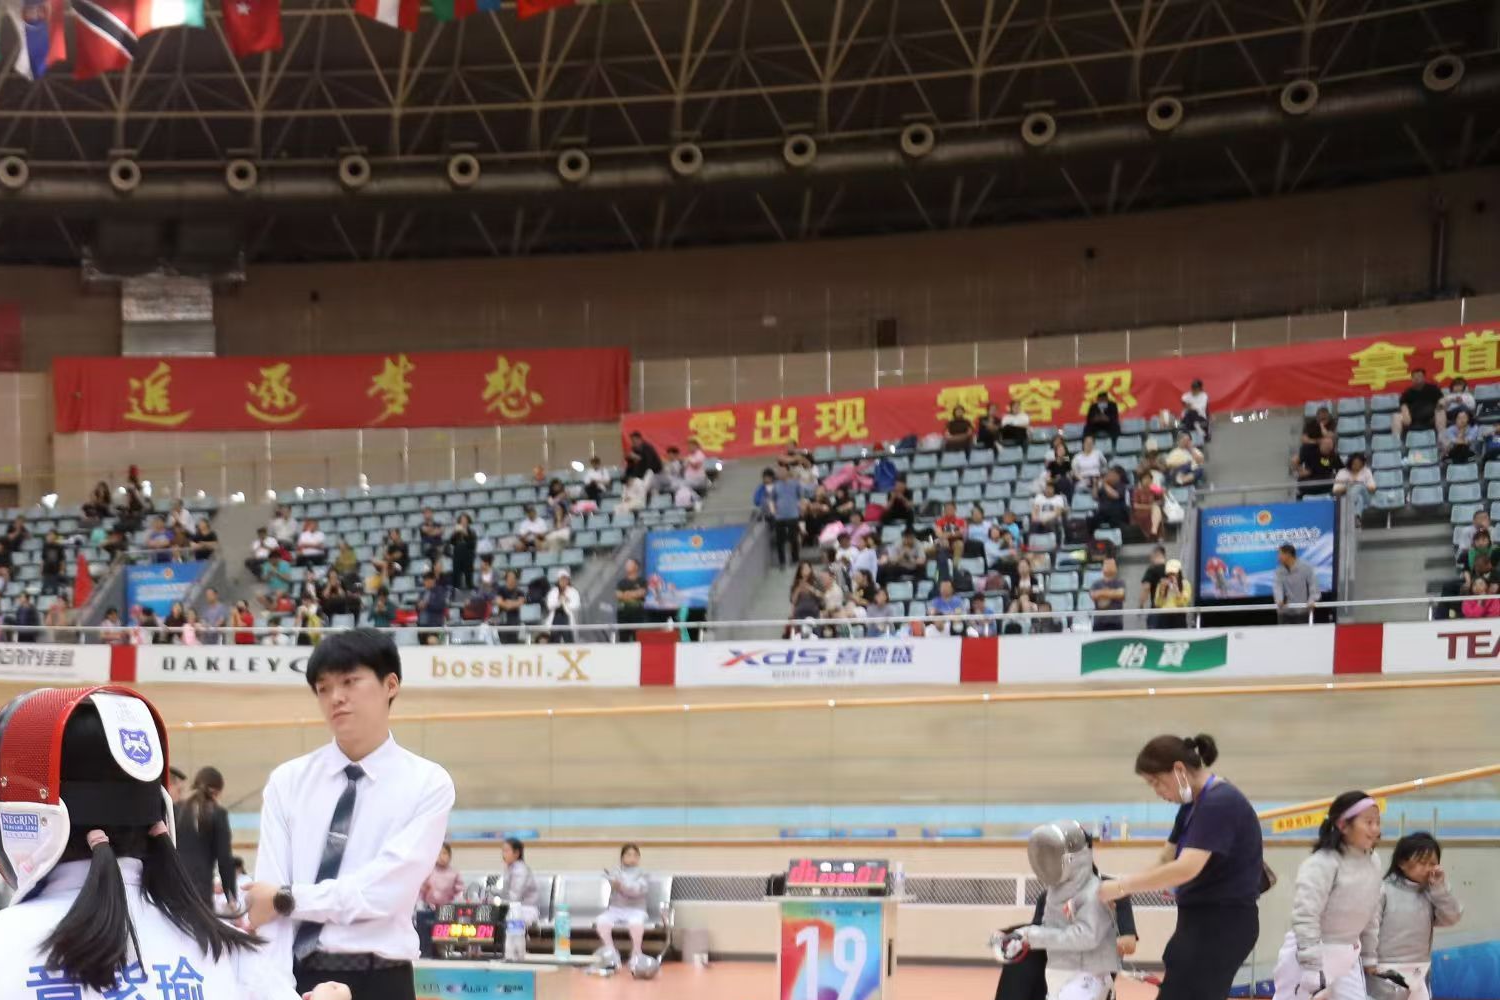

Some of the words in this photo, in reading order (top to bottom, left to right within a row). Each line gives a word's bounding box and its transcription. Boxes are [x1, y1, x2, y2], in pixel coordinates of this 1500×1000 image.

[688, 397, 869, 453] 零出现
[1437, 630, 1500, 660] TE
[162, 656, 289, 673] OAKLEY
[431, 648, 592, 683] bossini.X
[2, 815, 38, 825] NEGRINI
